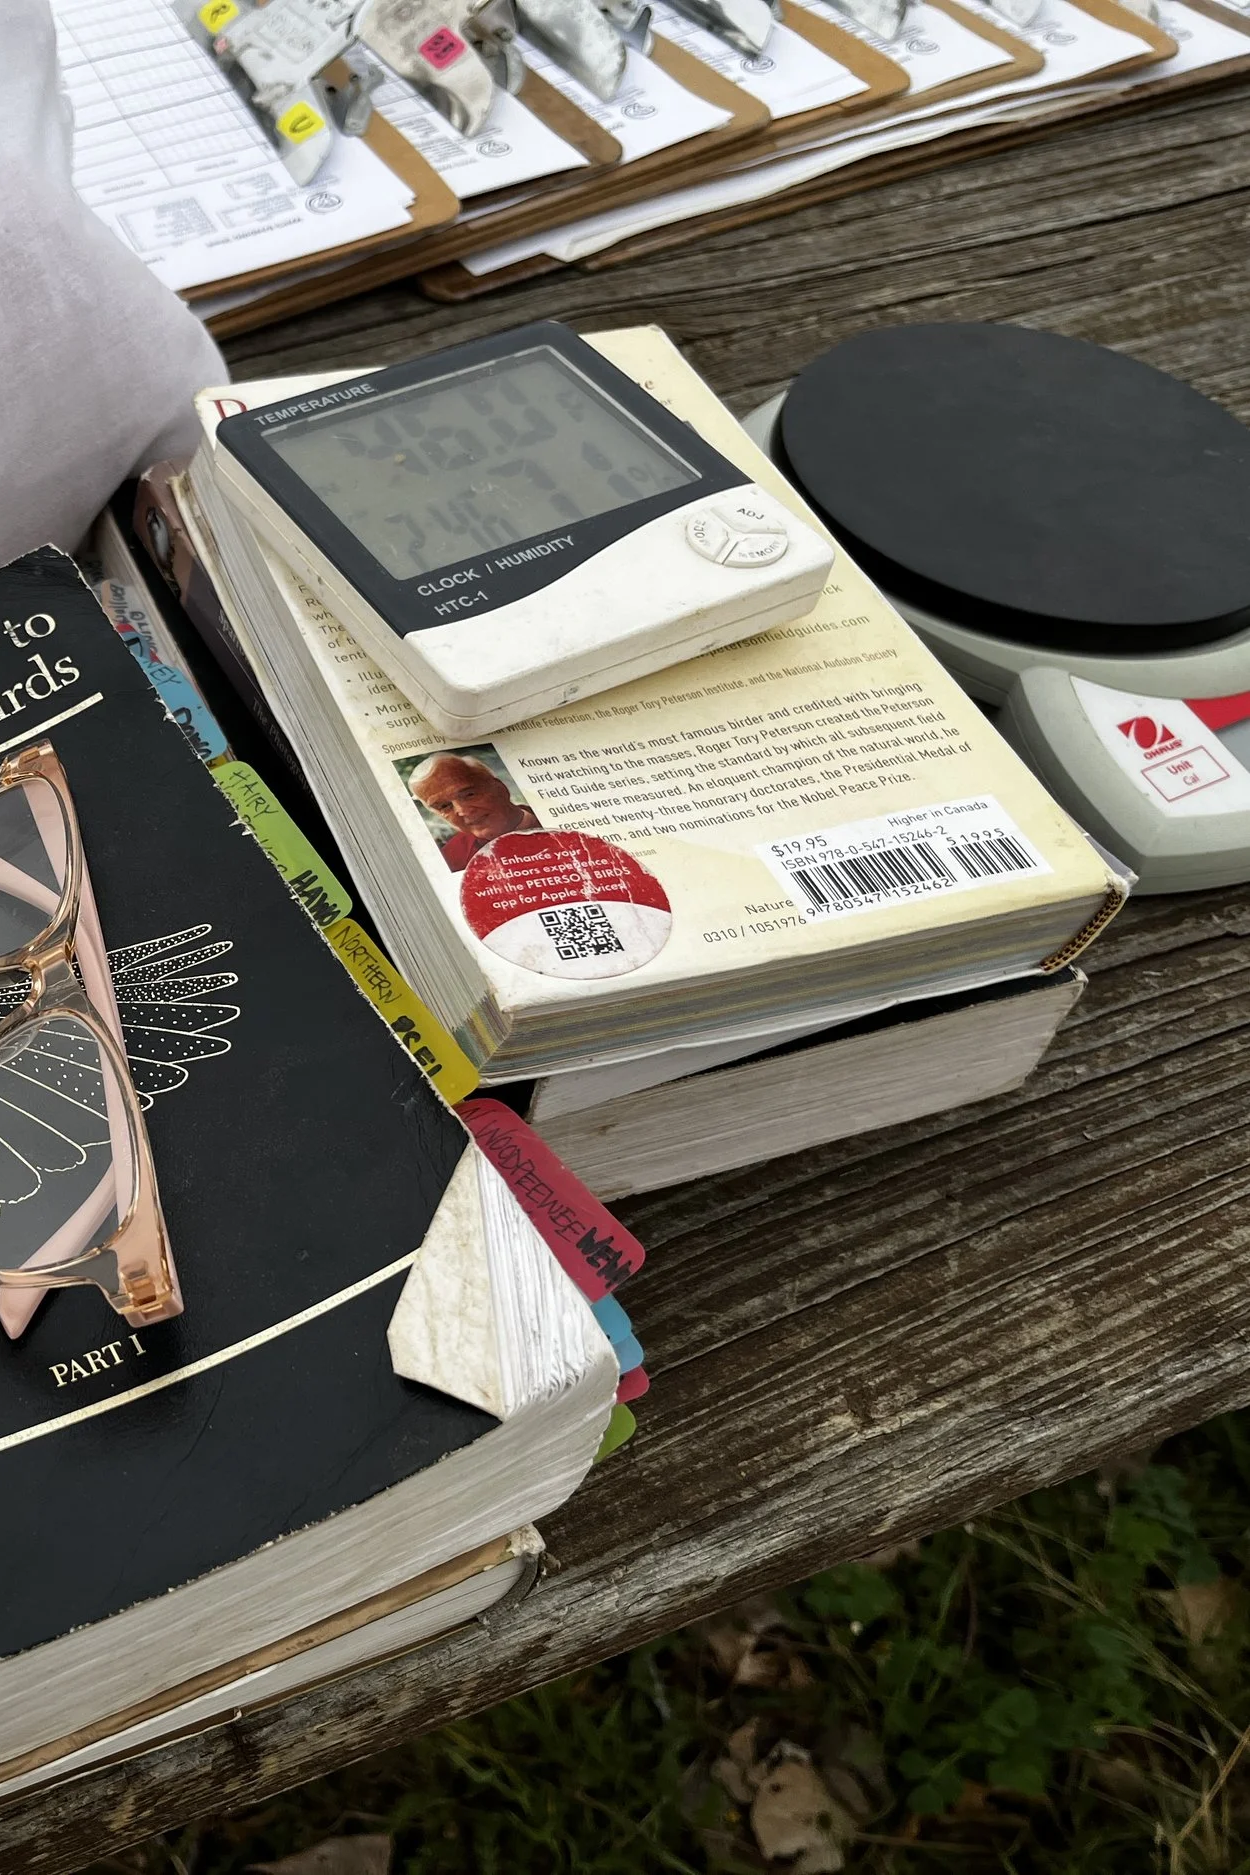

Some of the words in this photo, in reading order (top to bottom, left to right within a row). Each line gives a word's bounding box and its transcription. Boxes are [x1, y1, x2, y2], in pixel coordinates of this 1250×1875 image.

[254, 383, 376, 426] TEMPERATURE
[737, 508, 765, 520] ADJ
[417, 568, 482, 597] CLOCK
[494, 535, 576, 570] HUMIDITY
[434, 590, 489, 616] HTC-1
[2, 612, 57, 648] to
[542, 711, 595, 728] Federation,
[595, 709, 612, 720] the
[612, 703, 639, 716] Roger
[639, 696, 662, 711] Tory
[661, 689, 704, 706] Peterson
[703, 677, 748, 696] Institute,
[748, 673, 766, 686] and
[766, 669, 784, 681] the
[783, 661, 823, 676] National
[823, 654, 863, 669] Audubon
[862, 647, 898, 662] Society
[376, 702, 412, 716] More
[518, 753, 560, 769] Known
[562, 752, 578, 763] as
[579, 748, 600, 760] the
[601, 740, 646, 757] world's
[647, 733, 678, 748] most
[680, 723, 726, 741] famous
[727, 713, 764, 731] birder
[767, 707, 791, 722] and
[793, 695, 843, 715] credited
[843, 689, 871, 705] with
[872, 681, 923, 701] bringing
[381, 735, 434, 754] Sponsored
[433, 733, 447, 745] by
[528, 771, 553, 784] bird
[554, 762, 610, 782] watching
[610, 760, 624, 772] to
[624, 757, 645, 770] the
[646, 749, 696, 766] masses,
[695, 741, 732, 758] Roger
[732, 732, 760, 750] Tory
[760, 721, 815, 741] Peterson
[816, 710, 860, 728] created
[860, 706, 882, 720] the
[881, 696, 935, 714] Peterson
[537, 787, 570, 800] Field
[570, 780, 608, 796] Guide
[608, 774, 650, 790] series,
[650, 764, 695, 783] setting
[695, 760, 717, 773] the
[718, 744, 773, 768] standard
[772, 742, 789, 758] by
[790, 734, 828, 752] which
[829, 730, 847, 744] all
[847, 717, 916, 740] subsequent
[916, 711, 946, 726] field
[548, 801, 590, 818] guides
[590, 798, 621, 810] were
[623, 787, 687, 805] measured.
[687, 782, 704, 794] An
[705, 769, 761, 791] eloquent
[761, 755, 821, 776] champion
[822, 748, 837, 762] of
[836, 746, 859, 760] the
[859, 736, 903, 754] natural
[903, 731, 944, 748] world,
[945, 726, 960, 738] he
[1166, 760, 1193, 775] Unit
[1182, 773, 1200, 786] Cal
[229, 768, 279, 818] HAIRY
[558, 815, 611, 831] received
[612, 802, 693, 825] twenty-three
[694, 792, 748, 811] honorary
[749, 774, 820, 799] doctorates,
[820, 767, 843, 781] the
[843, 750, 920, 776] Presidential
[919, 744, 958, 760] Medal
[958, 740, 972, 754] of
[628, 827, 651, 841] and
[653, 823, 677, 835] two
[679, 809, 756, 831] nominations
[756, 801, 776, 816] for
[777, 796, 800, 810] the
[800, 788, 840, 806] Nobel
[839, 779, 878, 796] Peace
[878, 771, 916, 787] Prize.
[887, 811, 929, 828] Higher
[930, 807, 943, 818] in
[943, 801, 989, 817] Canada
[500, 852, 551, 866] Enhance
[553, 848, 581, 862] your
[771, 835, 828, 858] $19.95
[780, 853, 817, 871] ISBN
[818, 825, 948, 862] 978-0-547-15246-2
[475, 885, 502, 899] with
[504, 881, 524, 893] the
[594, 867, 631, 880] BIRDS
[486, 866, 541, 883] outdoors
[543, 857, 609, 875] experience
[492, 899, 517, 911] app
[518, 893, 537, 905] for
[539, 887, 578, 903] Apple
[744, 898, 795, 917] Nature
[703, 927, 738, 944] 0310
[748, 915, 808, 936] 1051976
[333, 925, 403, 1004] NORTHERN
[49, 1341, 124, 1388] PART
